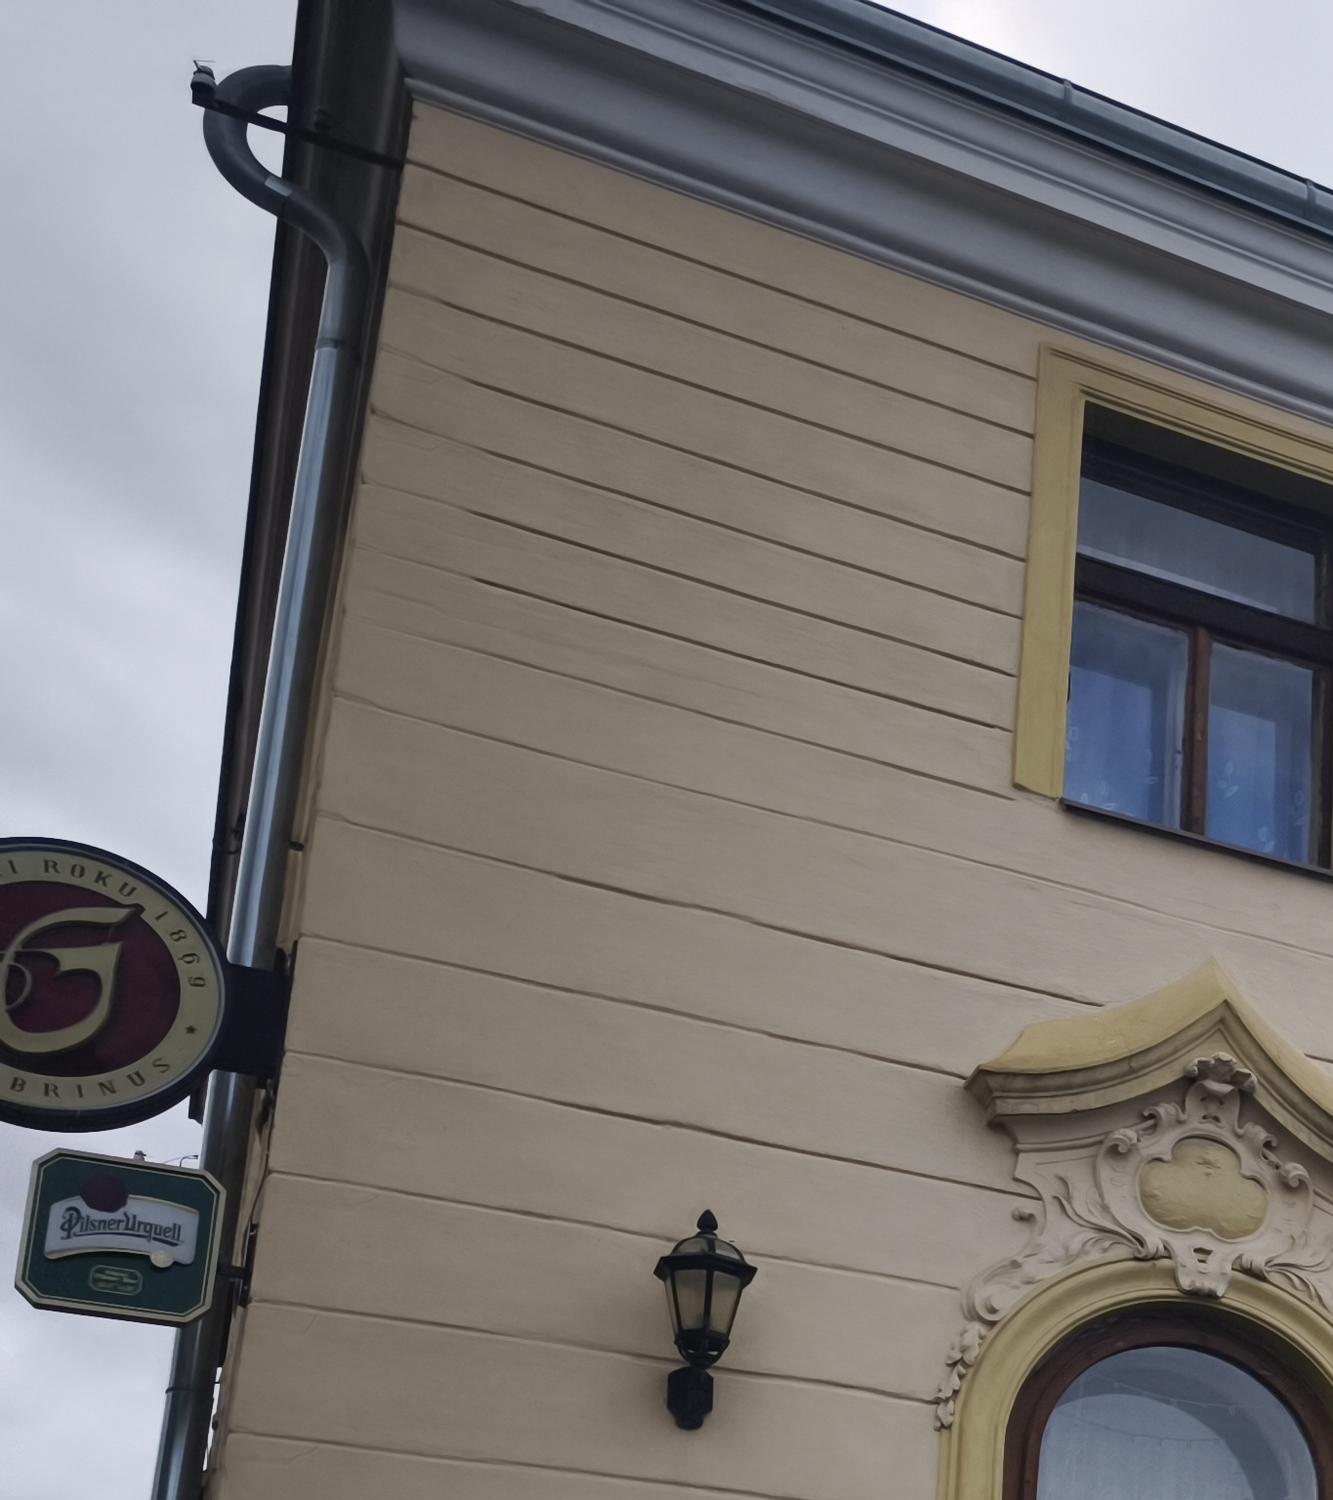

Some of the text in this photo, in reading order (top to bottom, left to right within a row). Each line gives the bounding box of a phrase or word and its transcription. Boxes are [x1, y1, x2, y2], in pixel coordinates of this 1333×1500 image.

[43, 859, 206, 988] ROKU 1869
[59, 1205, 182, 1243] Pilsner Urquell
